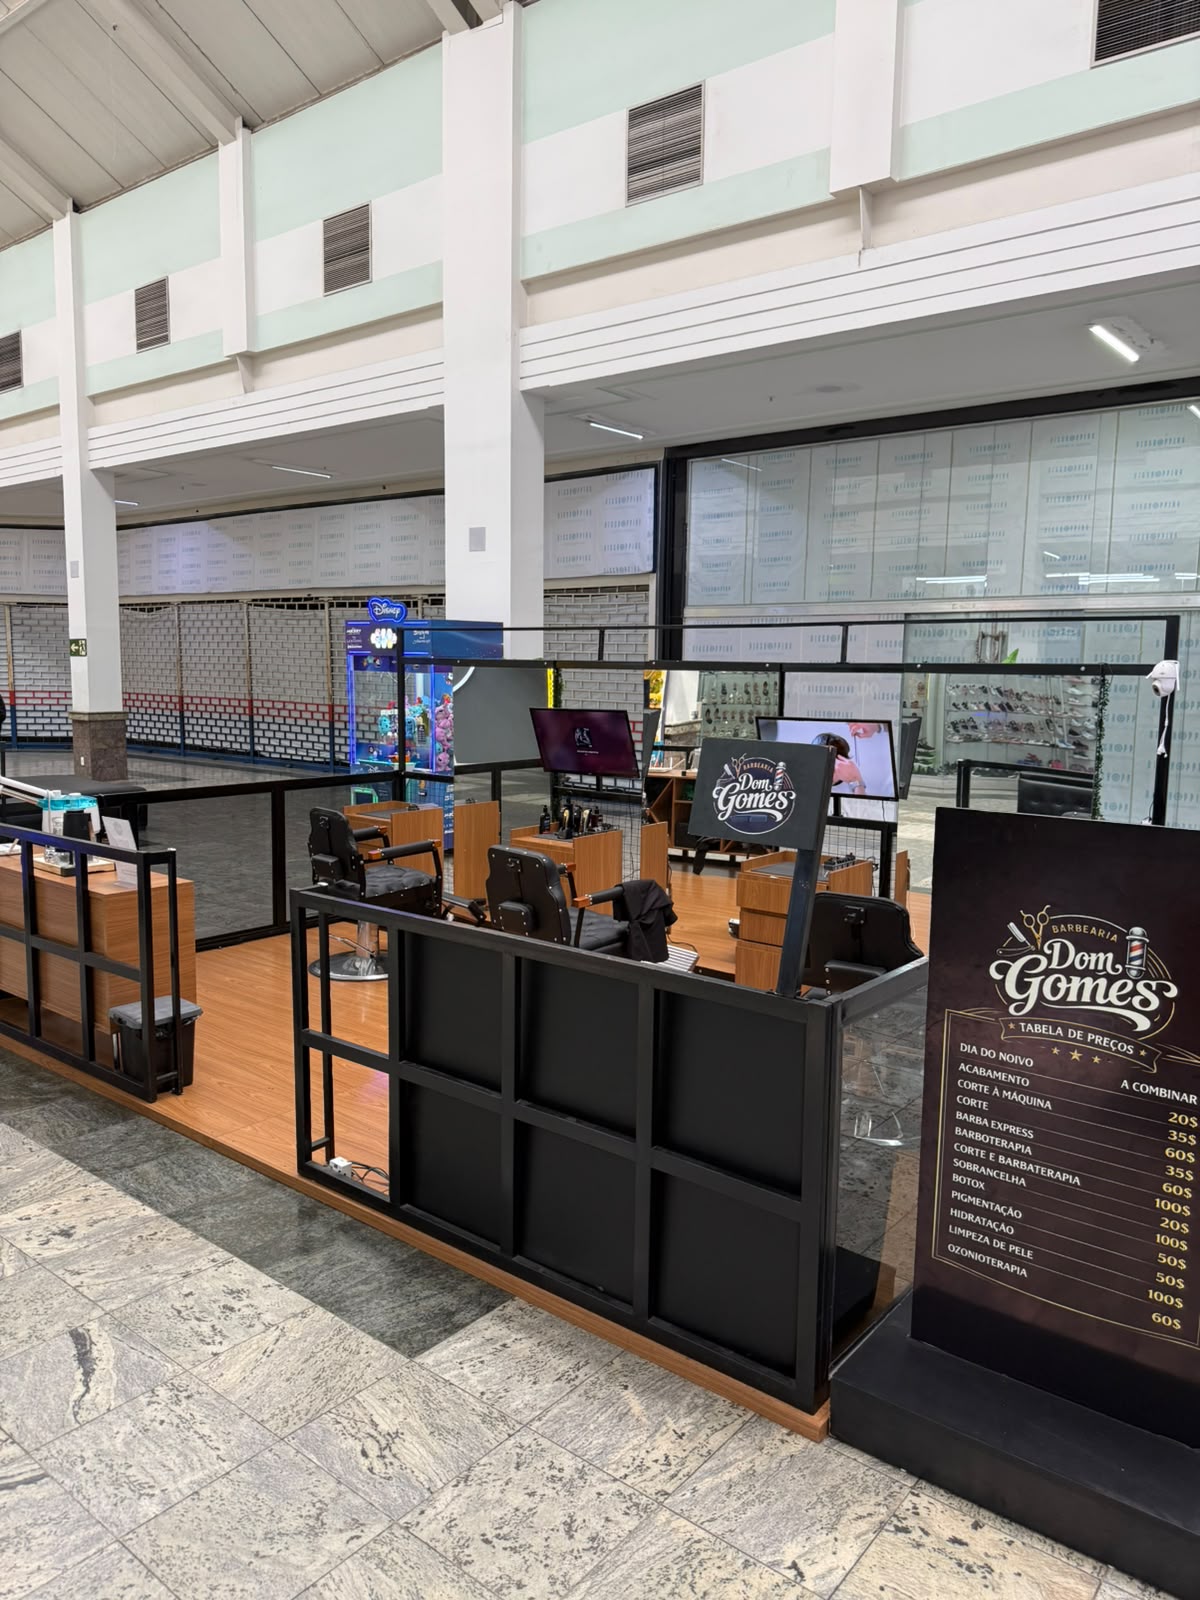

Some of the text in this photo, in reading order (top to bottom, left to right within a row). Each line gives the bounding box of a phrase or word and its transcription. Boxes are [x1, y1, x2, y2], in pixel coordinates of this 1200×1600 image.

[372, 601, 401, 619] Disney
[738, 772, 773, 793] Dom
[712, 782, 796, 822] Gomes
[1052, 923, 1118, 943] BARBEARIA
[1043, 938, 1122, 974] Dom
[989, 954, 1178, 1016] Gomes
[1019, 1022, 1134, 1055] TABELA DE PREÇOS
[960, 1042, 1034, 1068] DIA DO NOIVO
[958, 1062, 1030, 1087] ACABAMENTO
[956, 1095, 989, 1111] CORTE
[957, 1079, 990, 1095] CORTE
[1002, 1089, 1052, 1110] MÁQUINA
[1120, 1080, 1198, 1105] A COMBINAR
[955, 1110, 1034, 1139] BARBA EXPRESS
[1168, 1112, 1198, 1129] 20$
[954, 1126, 1033, 1156] BARBOTERAPIA
[1167, 1130, 1197, 1146] 35$
[953, 1142, 1081, 1186] CORTE E BARBATERAPIA
[1164, 1147, 1196, 1164] 60$
[952, 1158, 1027, 1188] SOBRANCELHA
[952, 1173, 986, 1190] BOTOX
[1165, 1165, 1194, 1182] 35$
[1162, 1182, 1192, 1199] 60$
[951, 1190, 1023, 1219] PIGMENTAÇÃO
[1154, 1198, 1191, 1217] 100$
[950, 1207, 1015, 1235] HIDRATAÇÃO
[1160, 1217, 1190, 1234] 20$
[948, 1224, 1034, 1260] LIMPEZA DE PELE
[1155, 1233, 1188, 1251] 100$
[947, 1243, 1028, 1278] OZONIOTERAPIA
[1157, 1252, 1187, 1270] 50$
[1155, 1272, 1185, 1289] 50$
[1147, 1289, 1184, 1309] 100$
[1151, 1312, 1181, 1330] 60$
